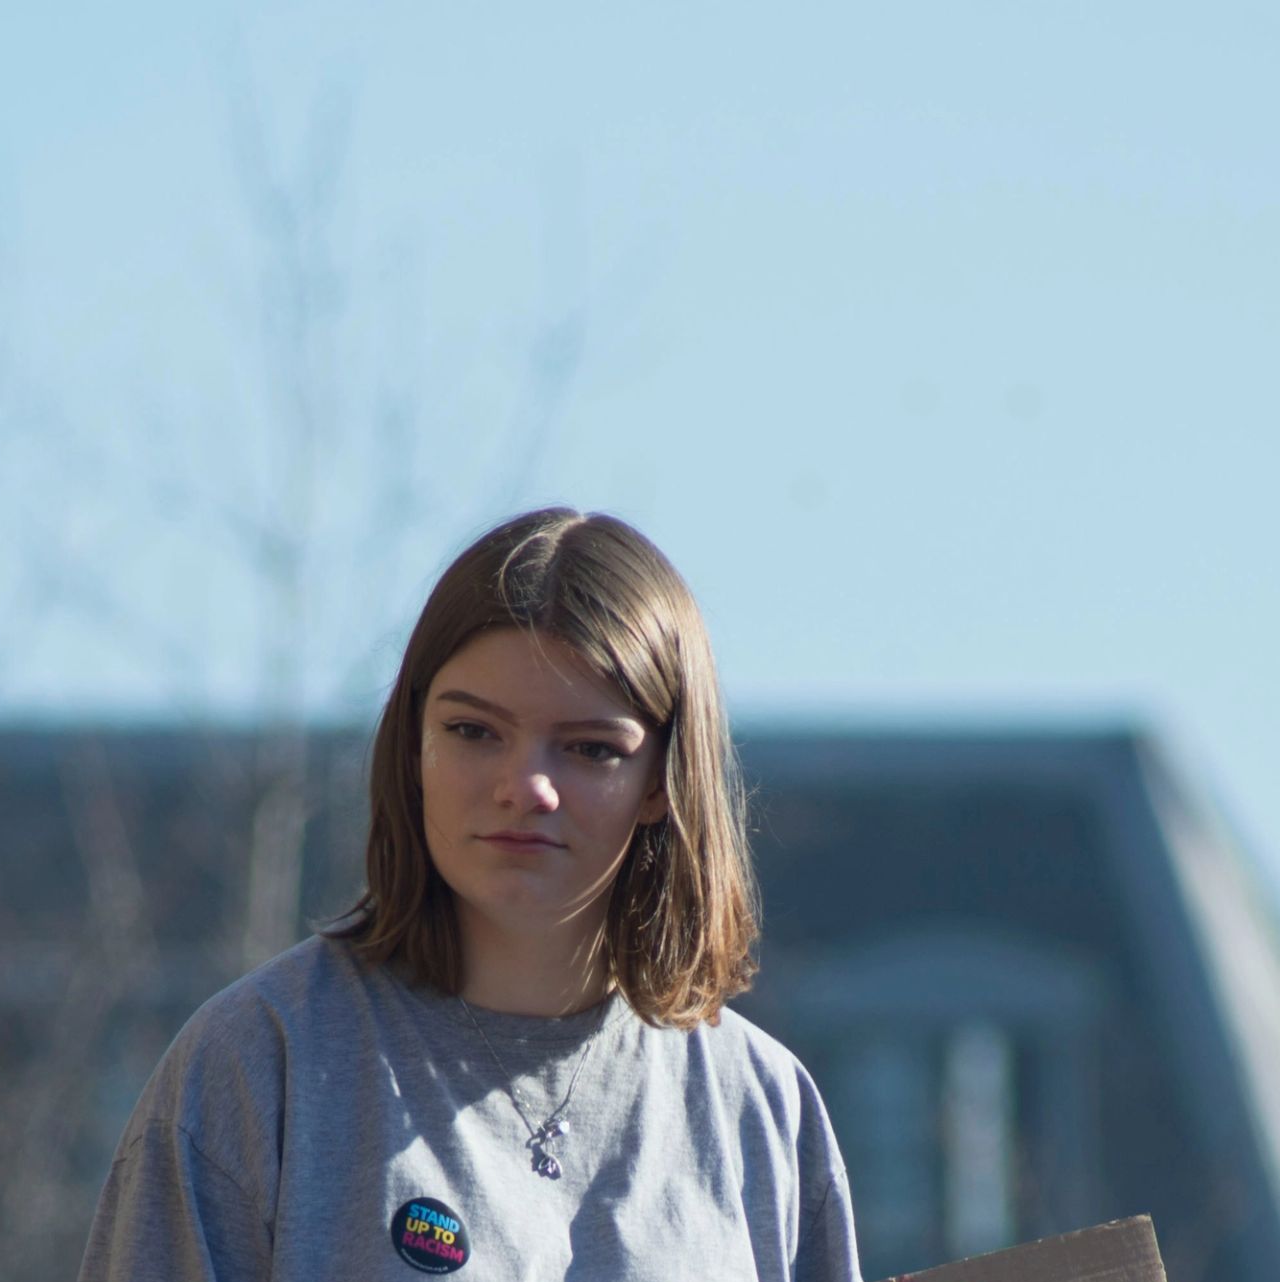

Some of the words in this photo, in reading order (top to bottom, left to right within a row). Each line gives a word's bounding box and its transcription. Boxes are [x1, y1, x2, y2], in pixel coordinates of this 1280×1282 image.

[405, 1217, 430, 1234] UP
[433, 1226, 456, 1245] TO
[407, 1203, 460, 1233] STAND
[401, 1231, 465, 1263] RACISM
